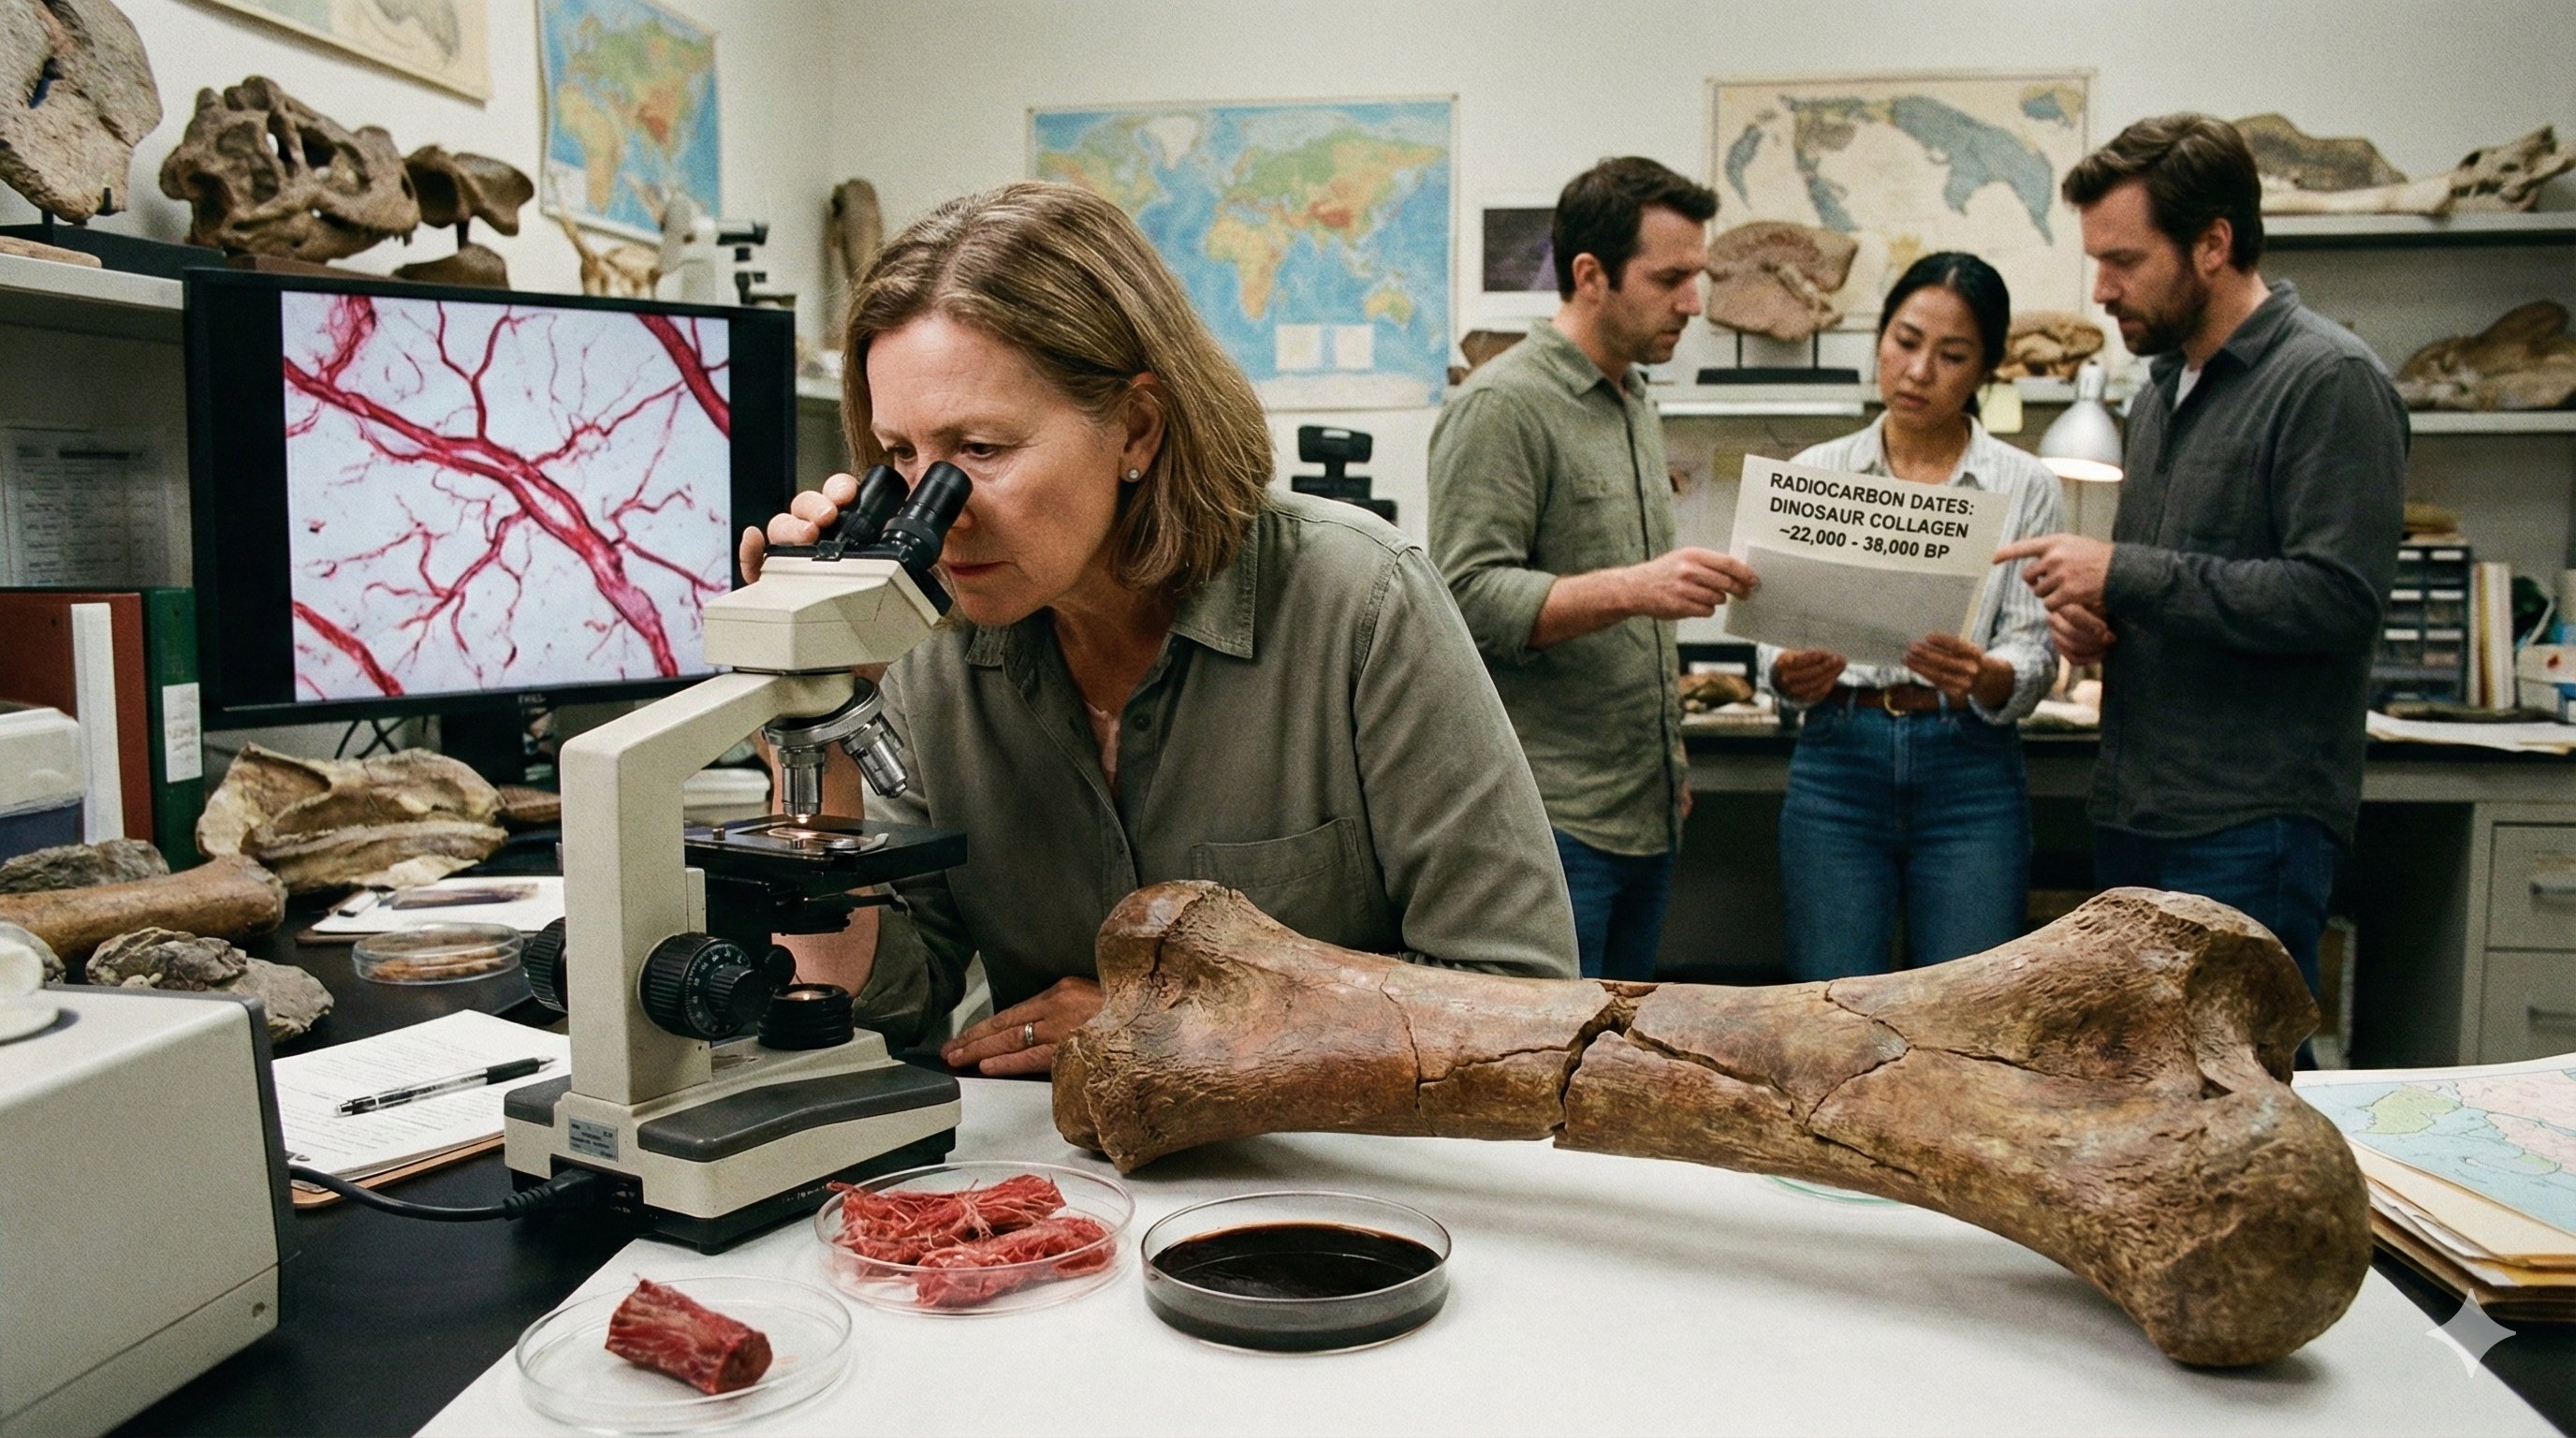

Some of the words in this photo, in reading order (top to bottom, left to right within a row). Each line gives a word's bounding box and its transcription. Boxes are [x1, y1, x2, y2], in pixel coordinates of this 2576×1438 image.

[1770, 472, 1905, 507] RADIOCARBON
[1910, 493, 1974, 515] DATES:
[1770, 496, 1865, 526] DINOSAUR
[1869, 513, 1969, 538] COLLAGEN
[1863, 536, 1919, 556] 38,000
[1924, 543, 1950, 559] BP
